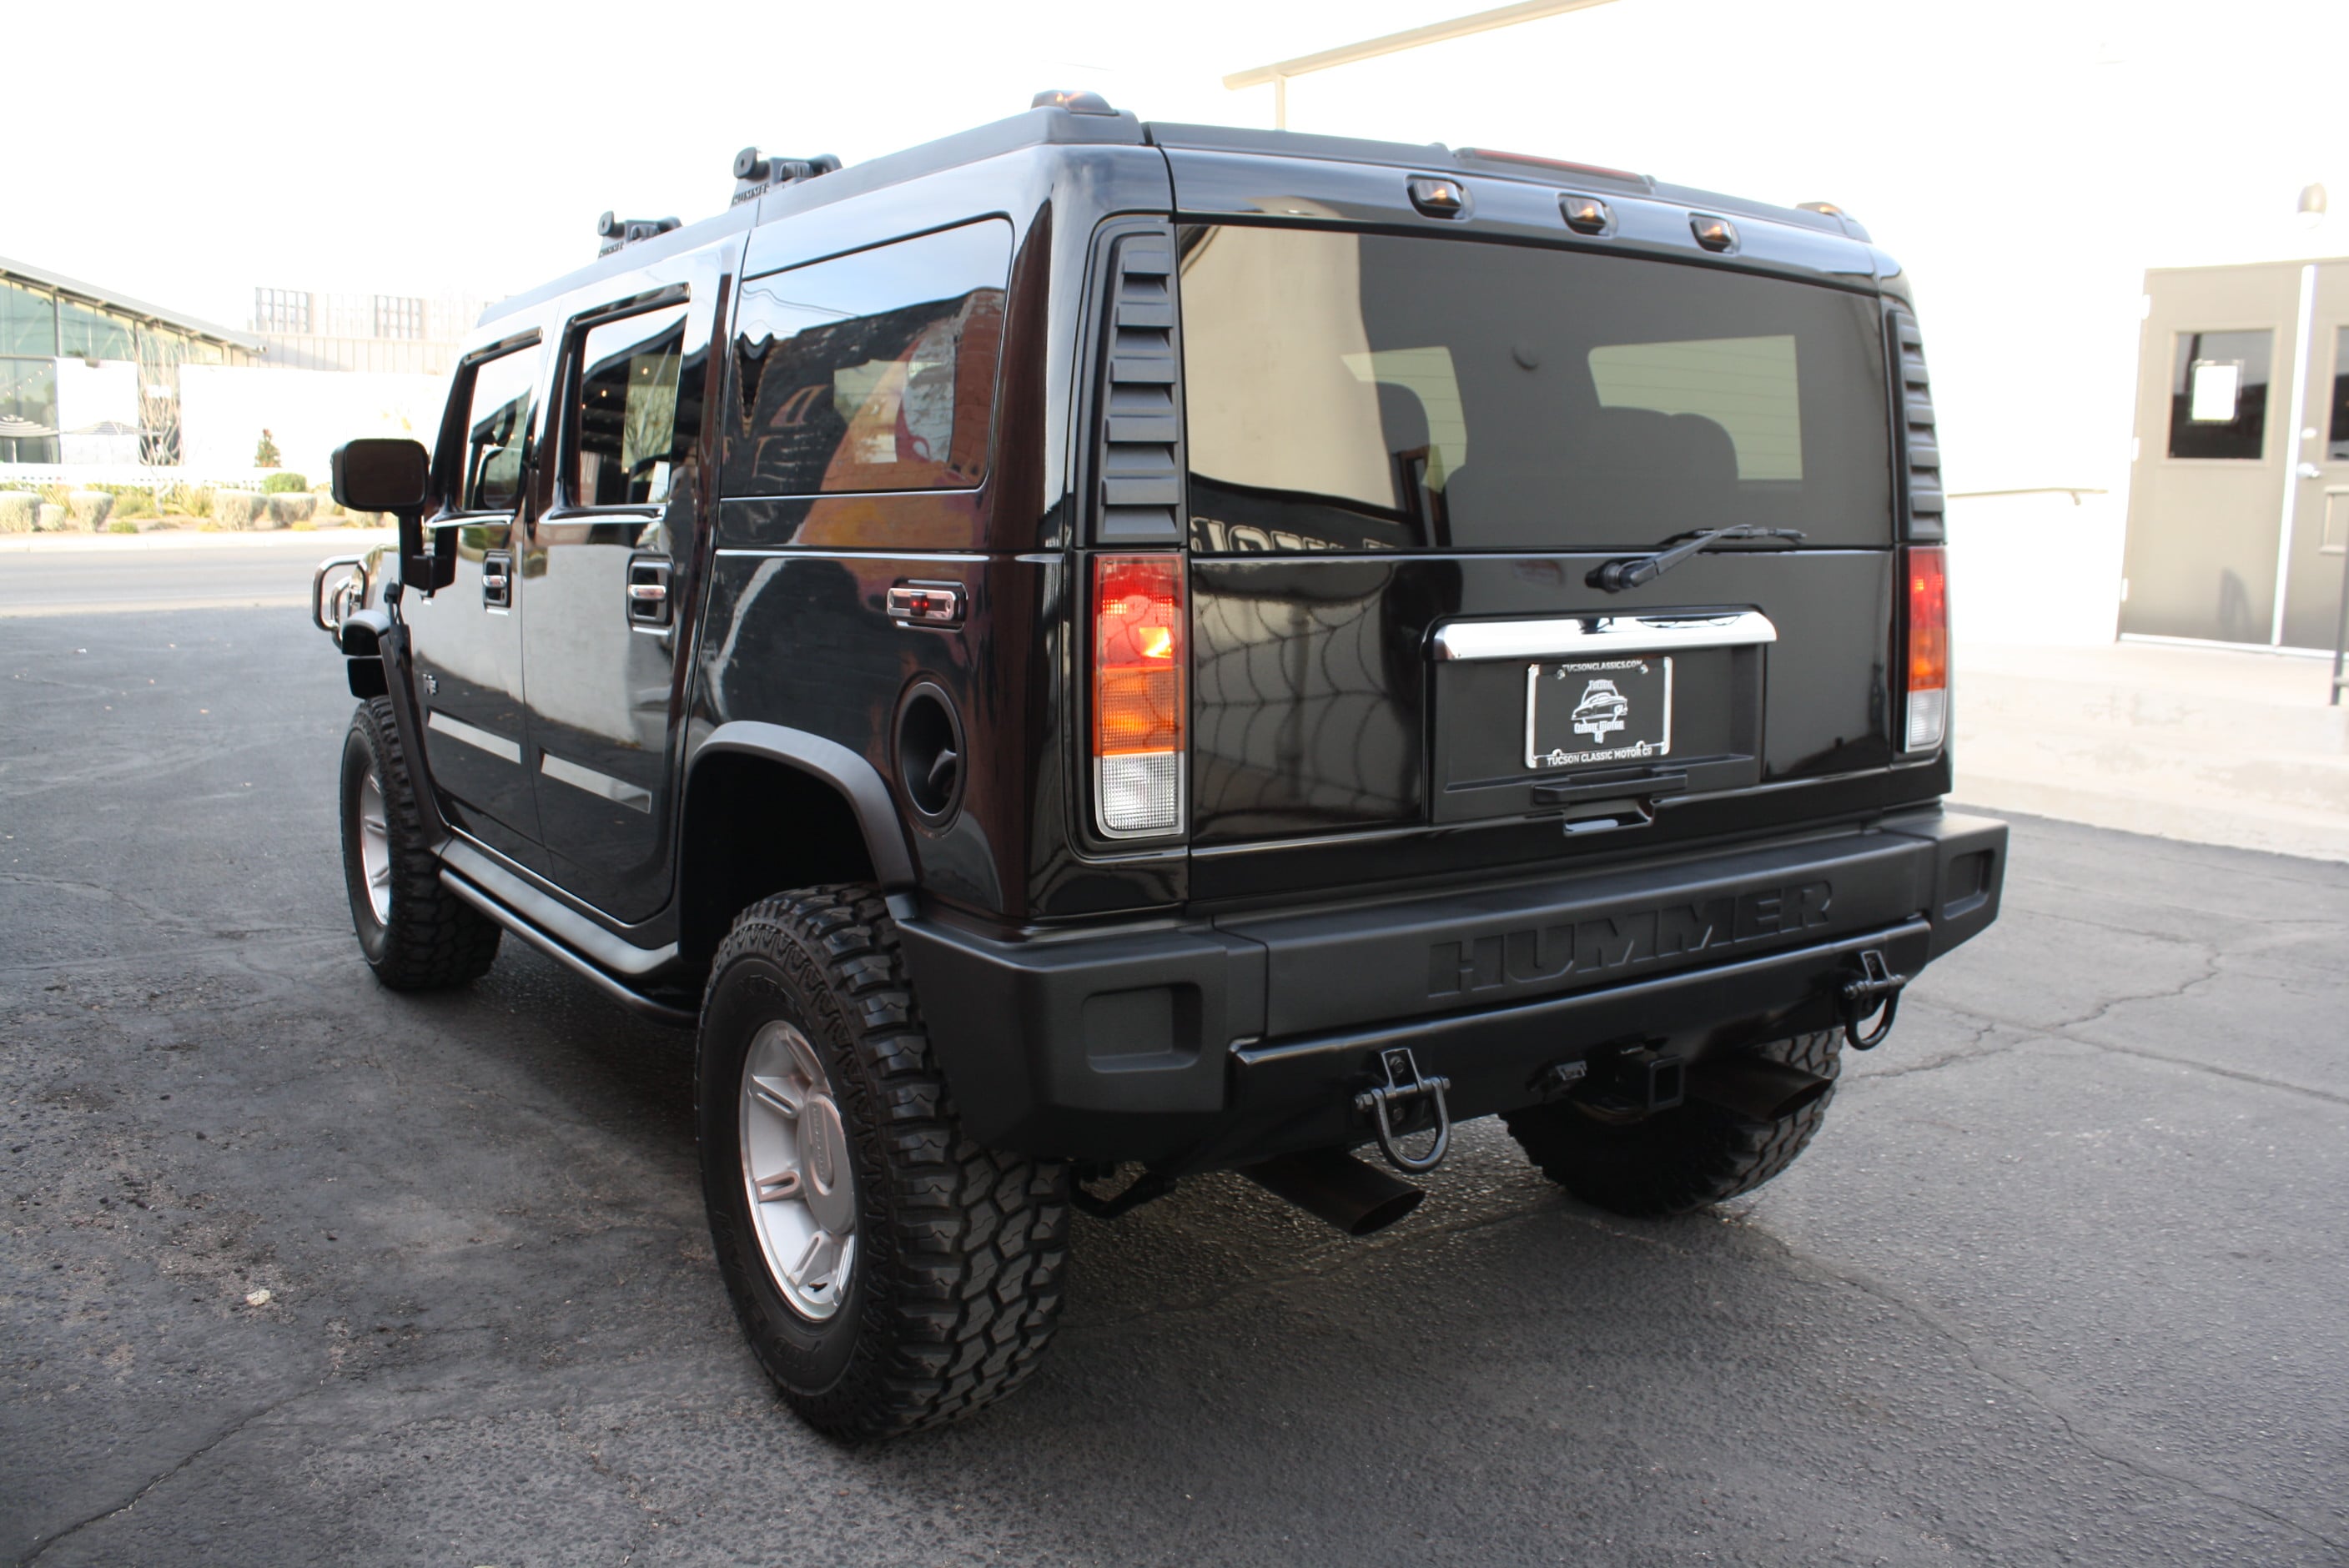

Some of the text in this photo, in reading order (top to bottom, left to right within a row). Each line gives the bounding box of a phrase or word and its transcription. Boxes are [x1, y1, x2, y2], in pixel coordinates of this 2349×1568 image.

[1562, 660, 1642, 672] TUCSONCLASSICS.COM
[1547, 753, 1579, 766] TUCSON
[1581, 751, 1612, 762] CLASSIC
[1614, 747, 1642, 759] MOTOR
[1427, 879, 1833, 998] HUMMER
